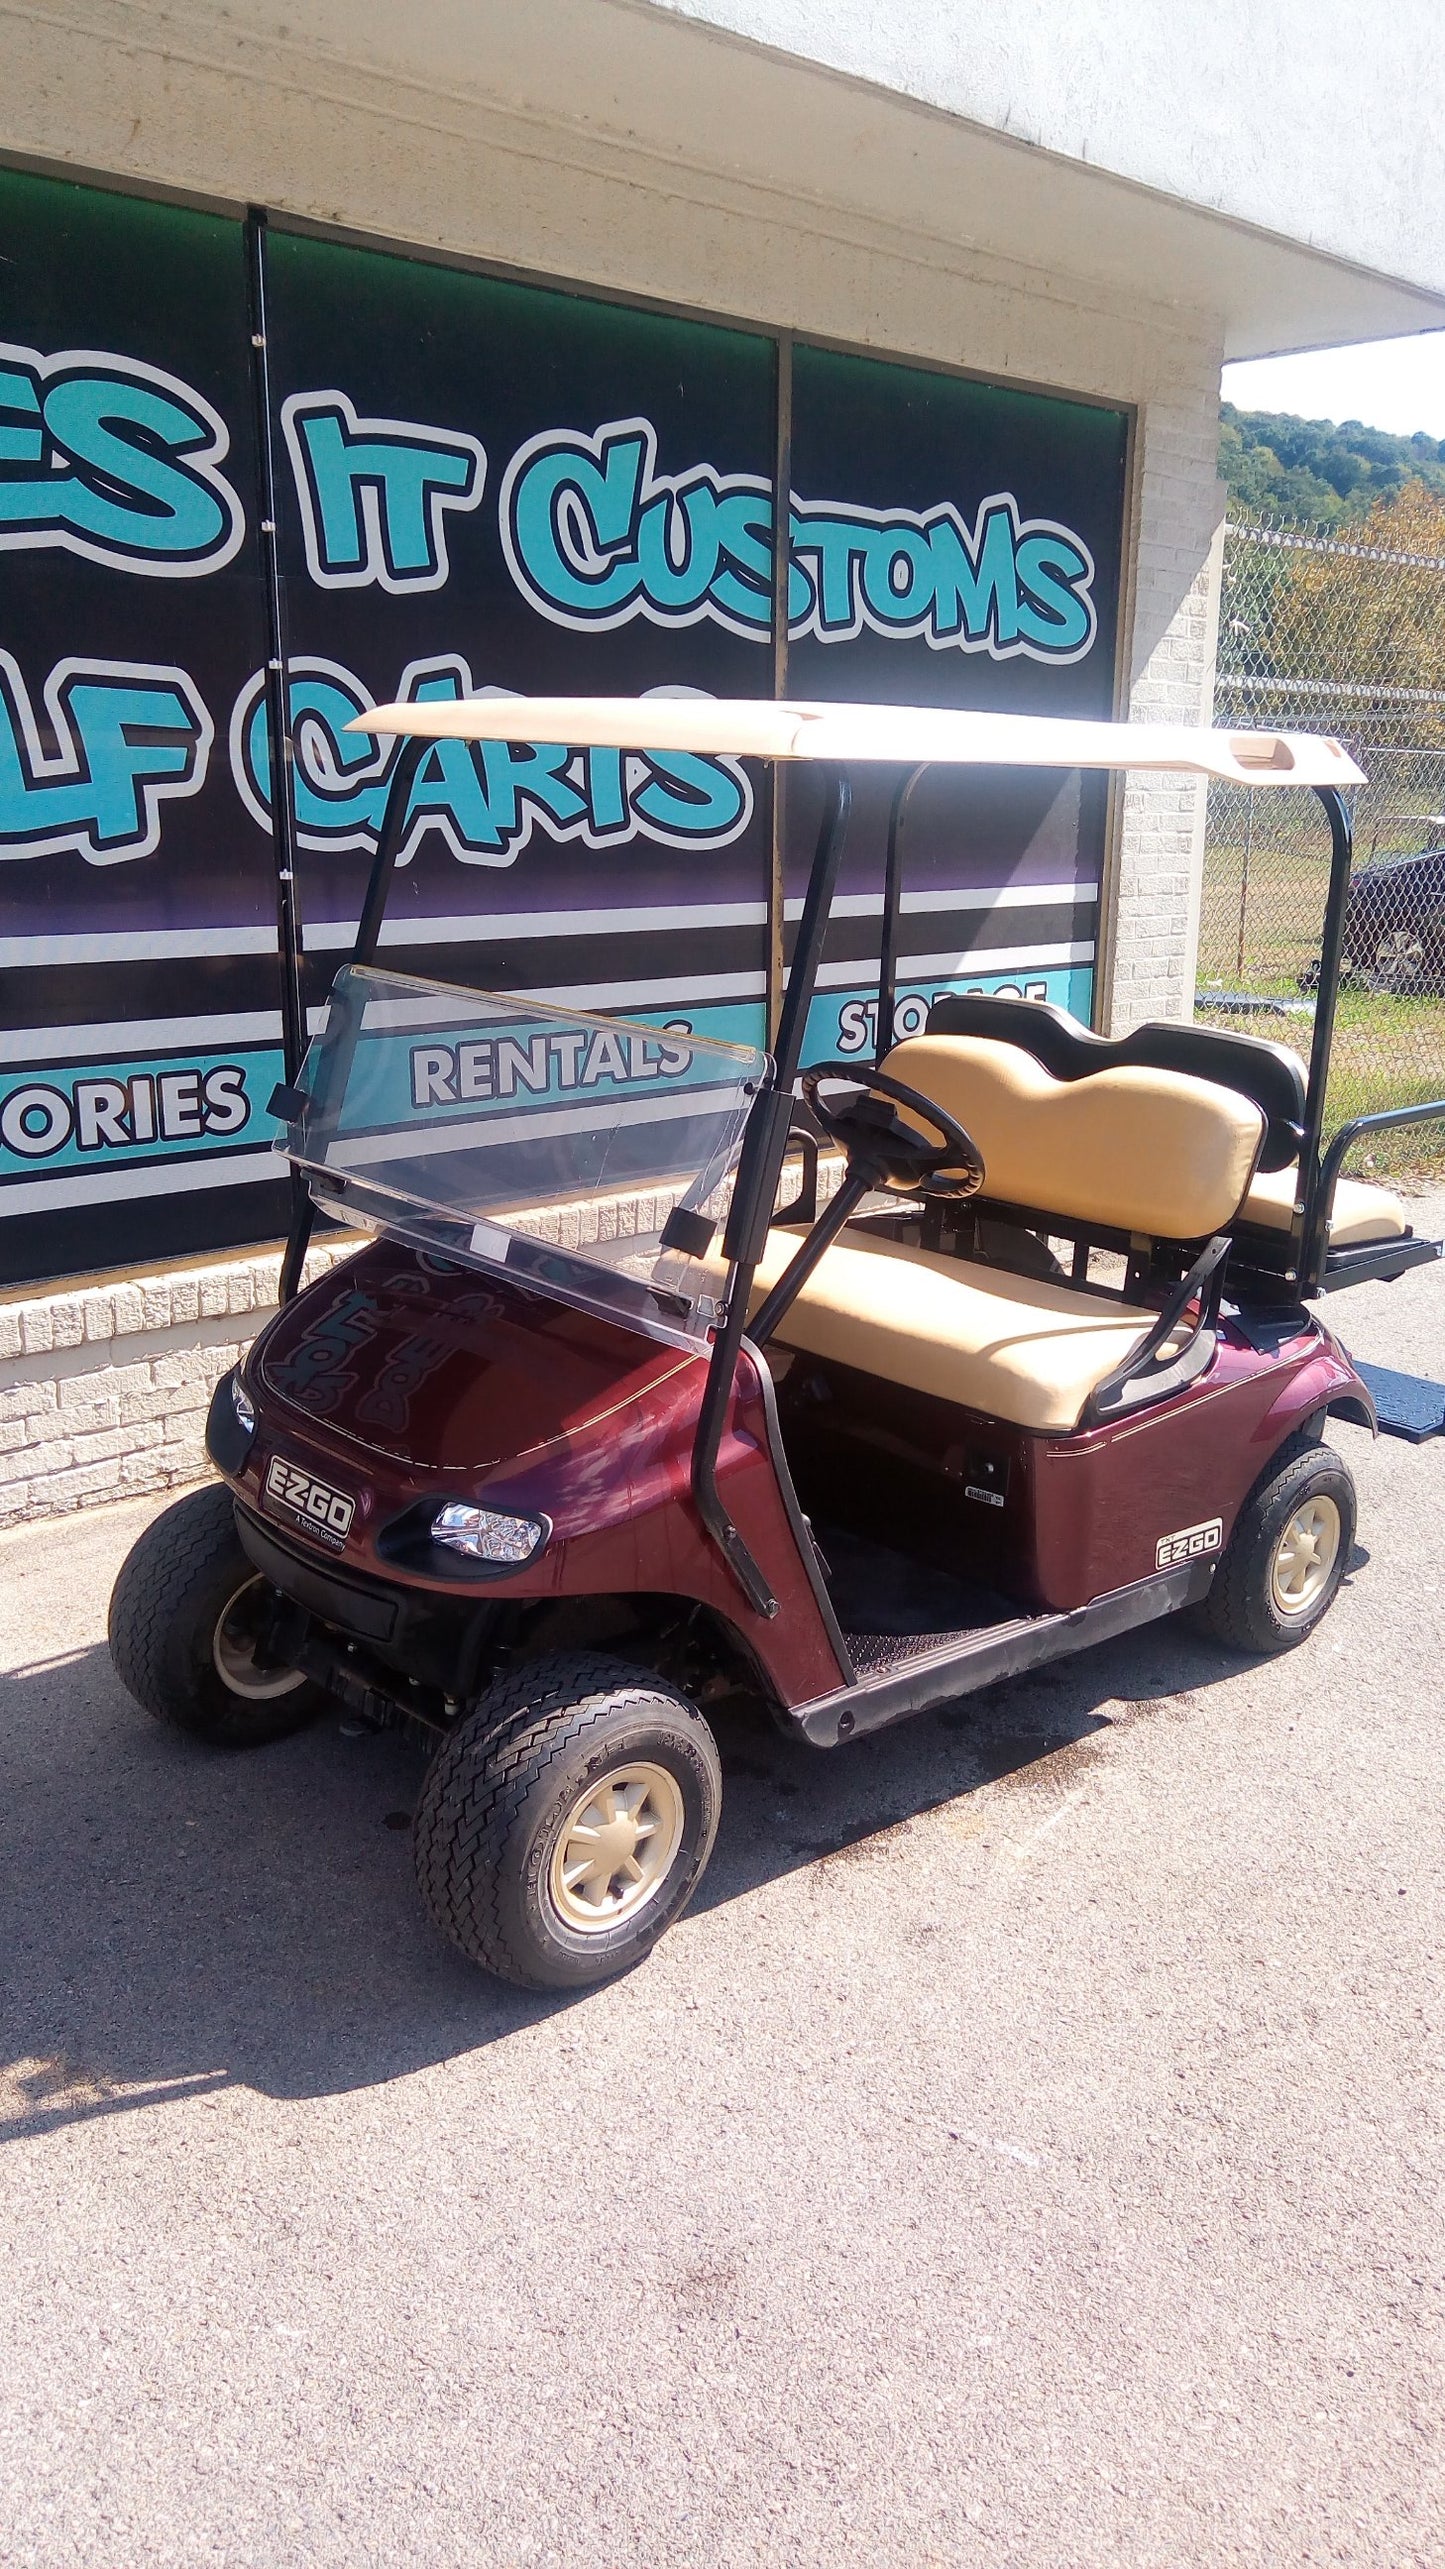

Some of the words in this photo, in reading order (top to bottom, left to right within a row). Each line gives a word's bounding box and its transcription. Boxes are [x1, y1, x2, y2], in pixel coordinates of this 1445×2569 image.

[290, 402, 481, 584] IT
[506, 426, 1093, 658] CUSTOMS
[410, 1020, 693, 1109] RENTALS
[0, 1065, 249, 1159] ORIES
[300, 1517, 320, 1534] Textron
[320, 1530, 345, 1552] Company
